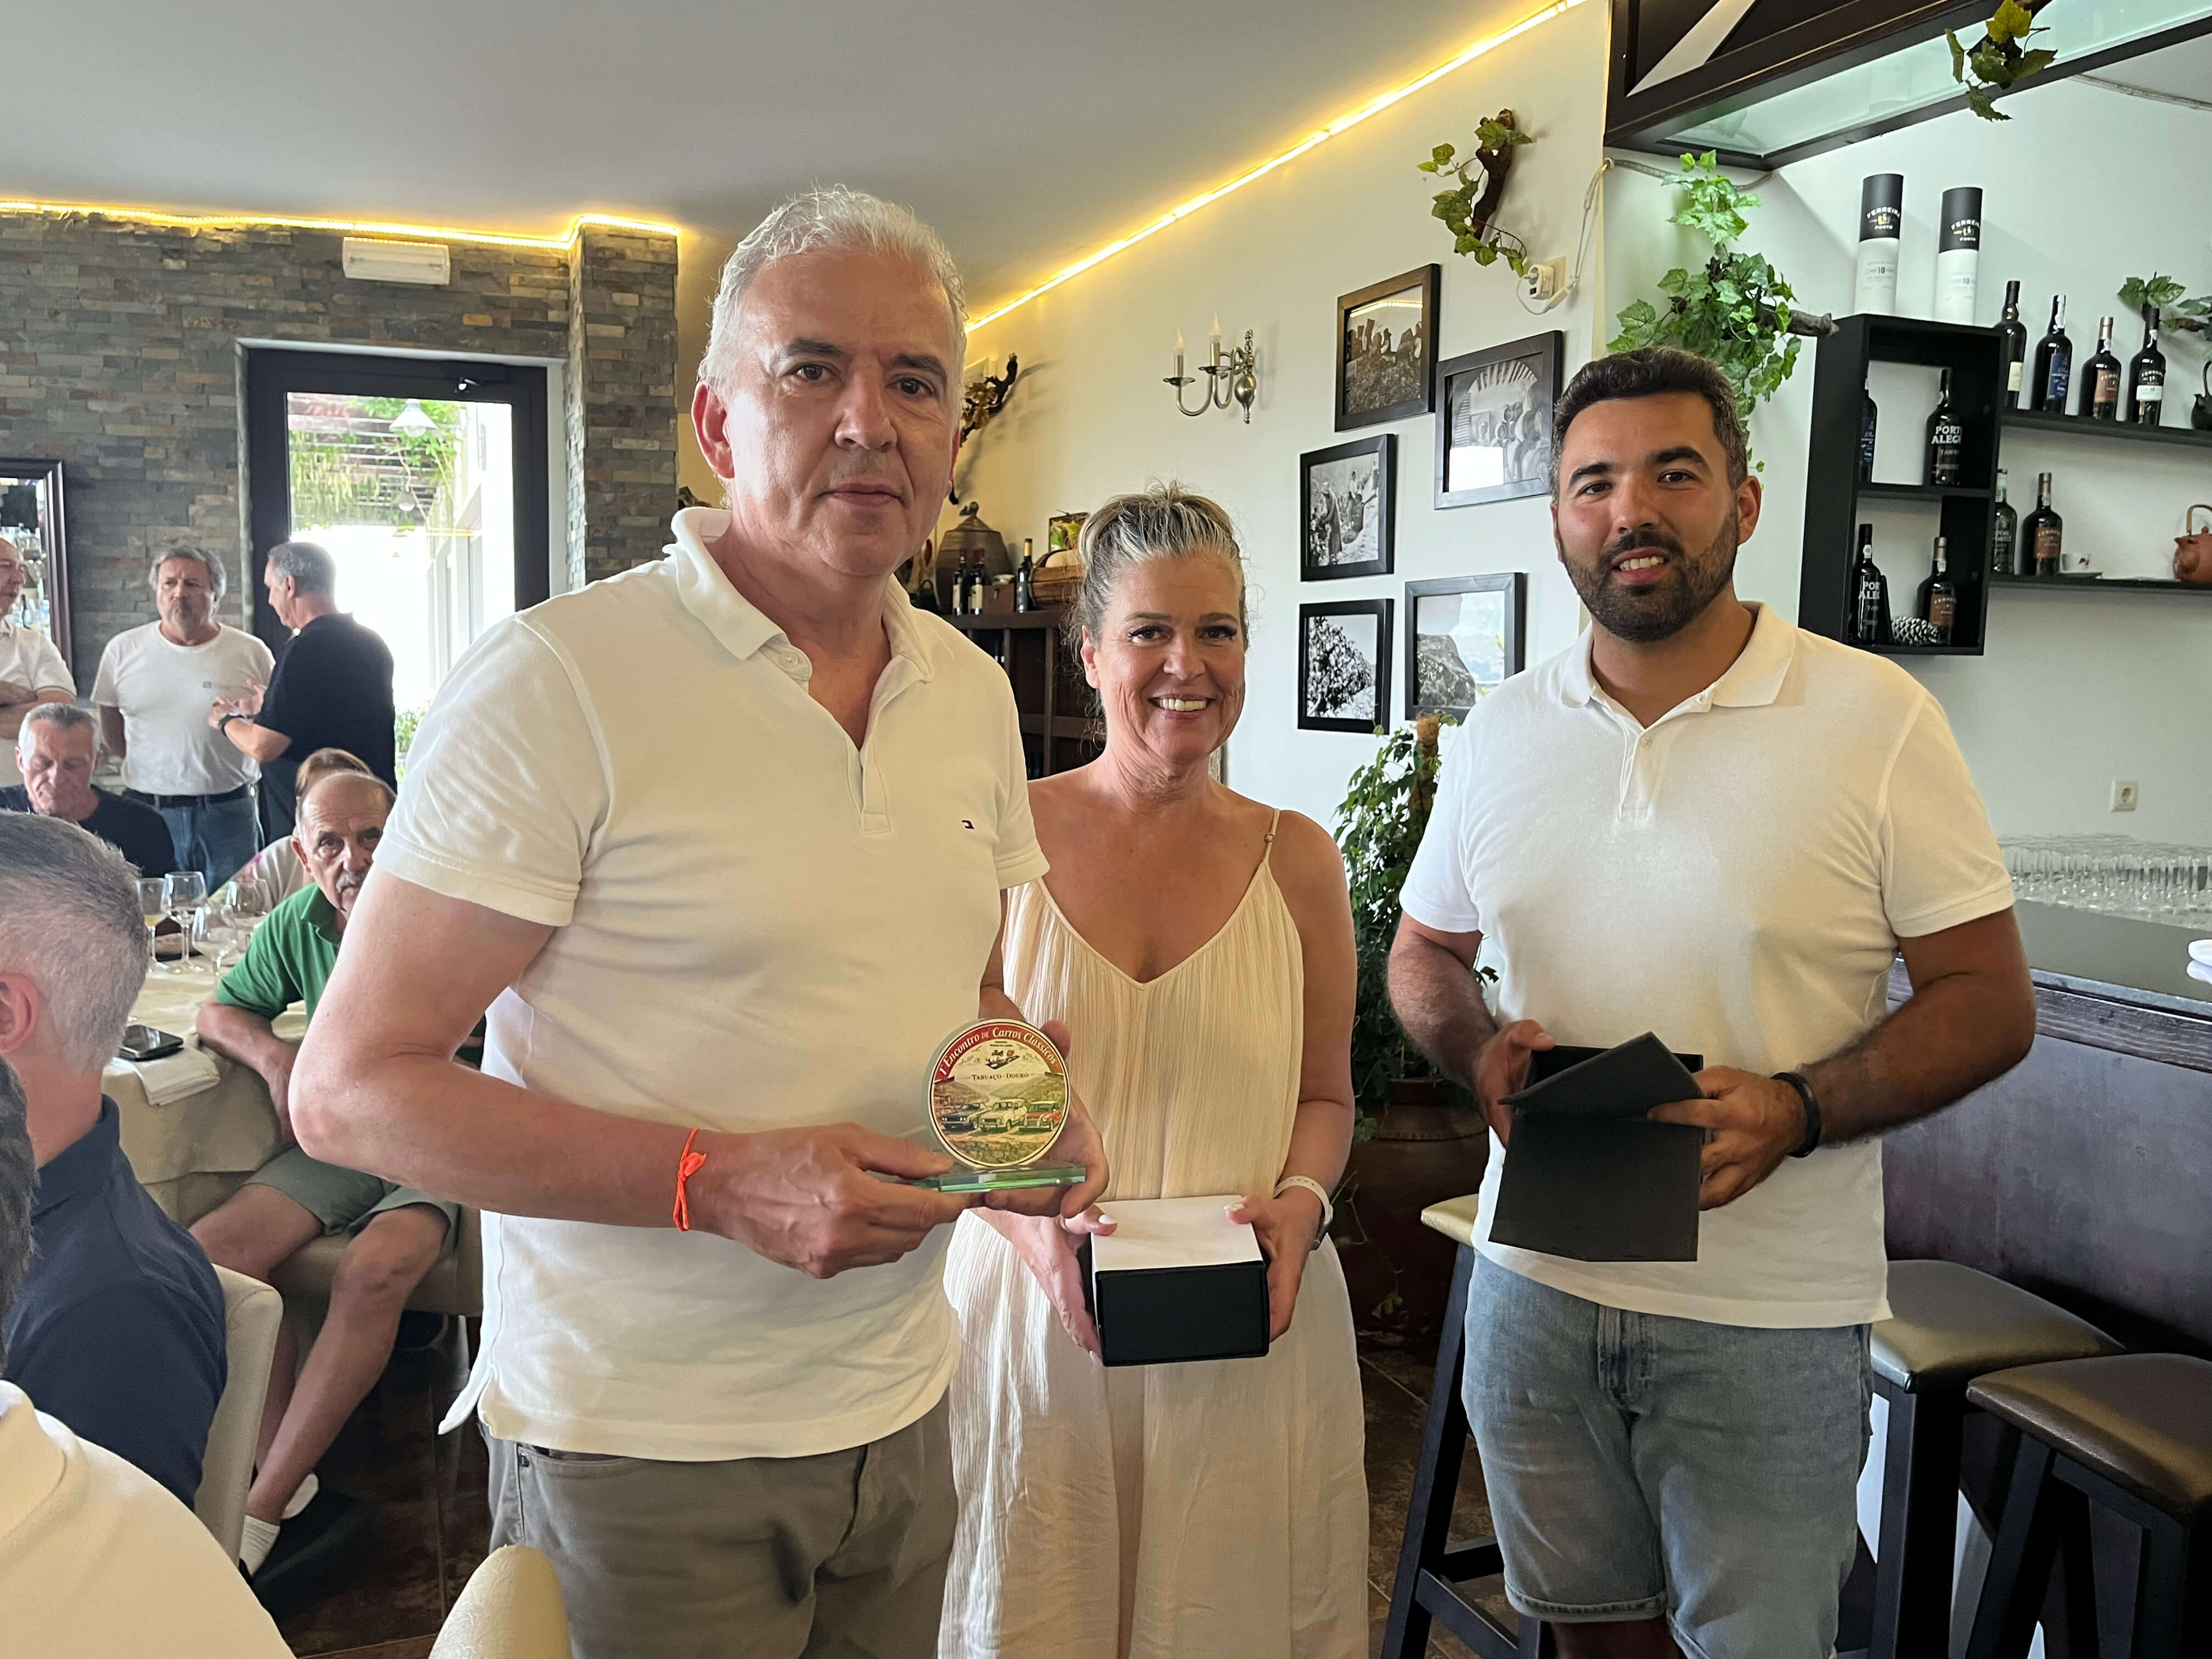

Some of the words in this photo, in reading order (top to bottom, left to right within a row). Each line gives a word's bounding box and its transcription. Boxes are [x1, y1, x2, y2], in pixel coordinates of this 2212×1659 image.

[943, 1034, 980, 1068] Encontro
[981, 1031, 989, 1040] DE
[992, 1026, 1022, 1040] Carros
